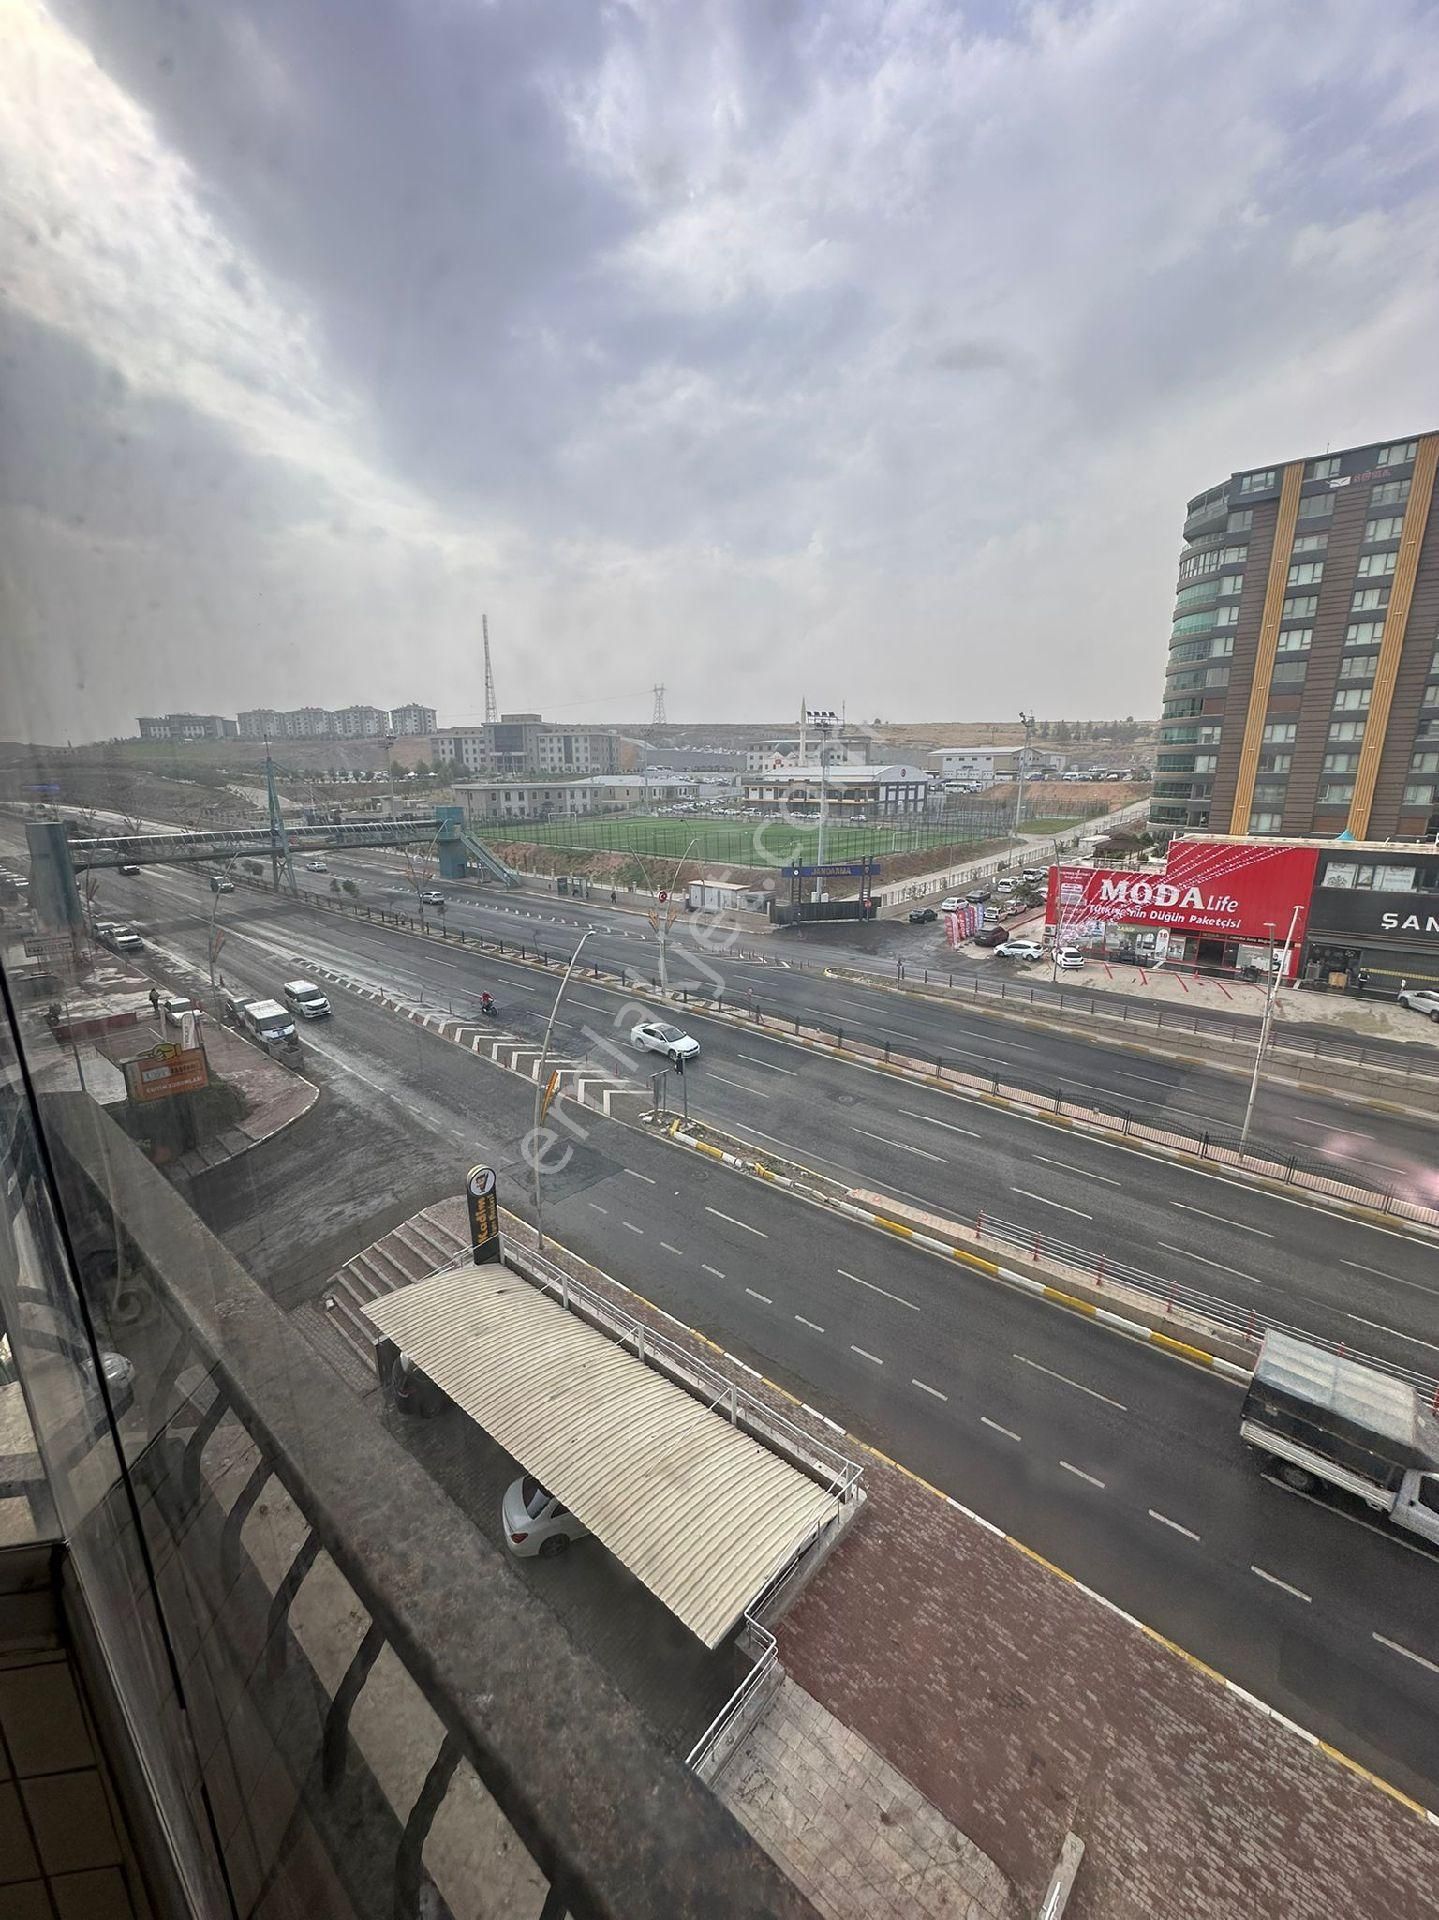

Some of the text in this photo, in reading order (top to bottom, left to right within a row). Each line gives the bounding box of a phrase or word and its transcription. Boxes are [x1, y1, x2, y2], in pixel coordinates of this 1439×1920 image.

[1101, 879, 1205, 909] MODA
[1206, 895, 1239, 913] Life
[1150, 910, 1185, 923] Düğün
[1189, 914, 1241, 929] Paketçisi
